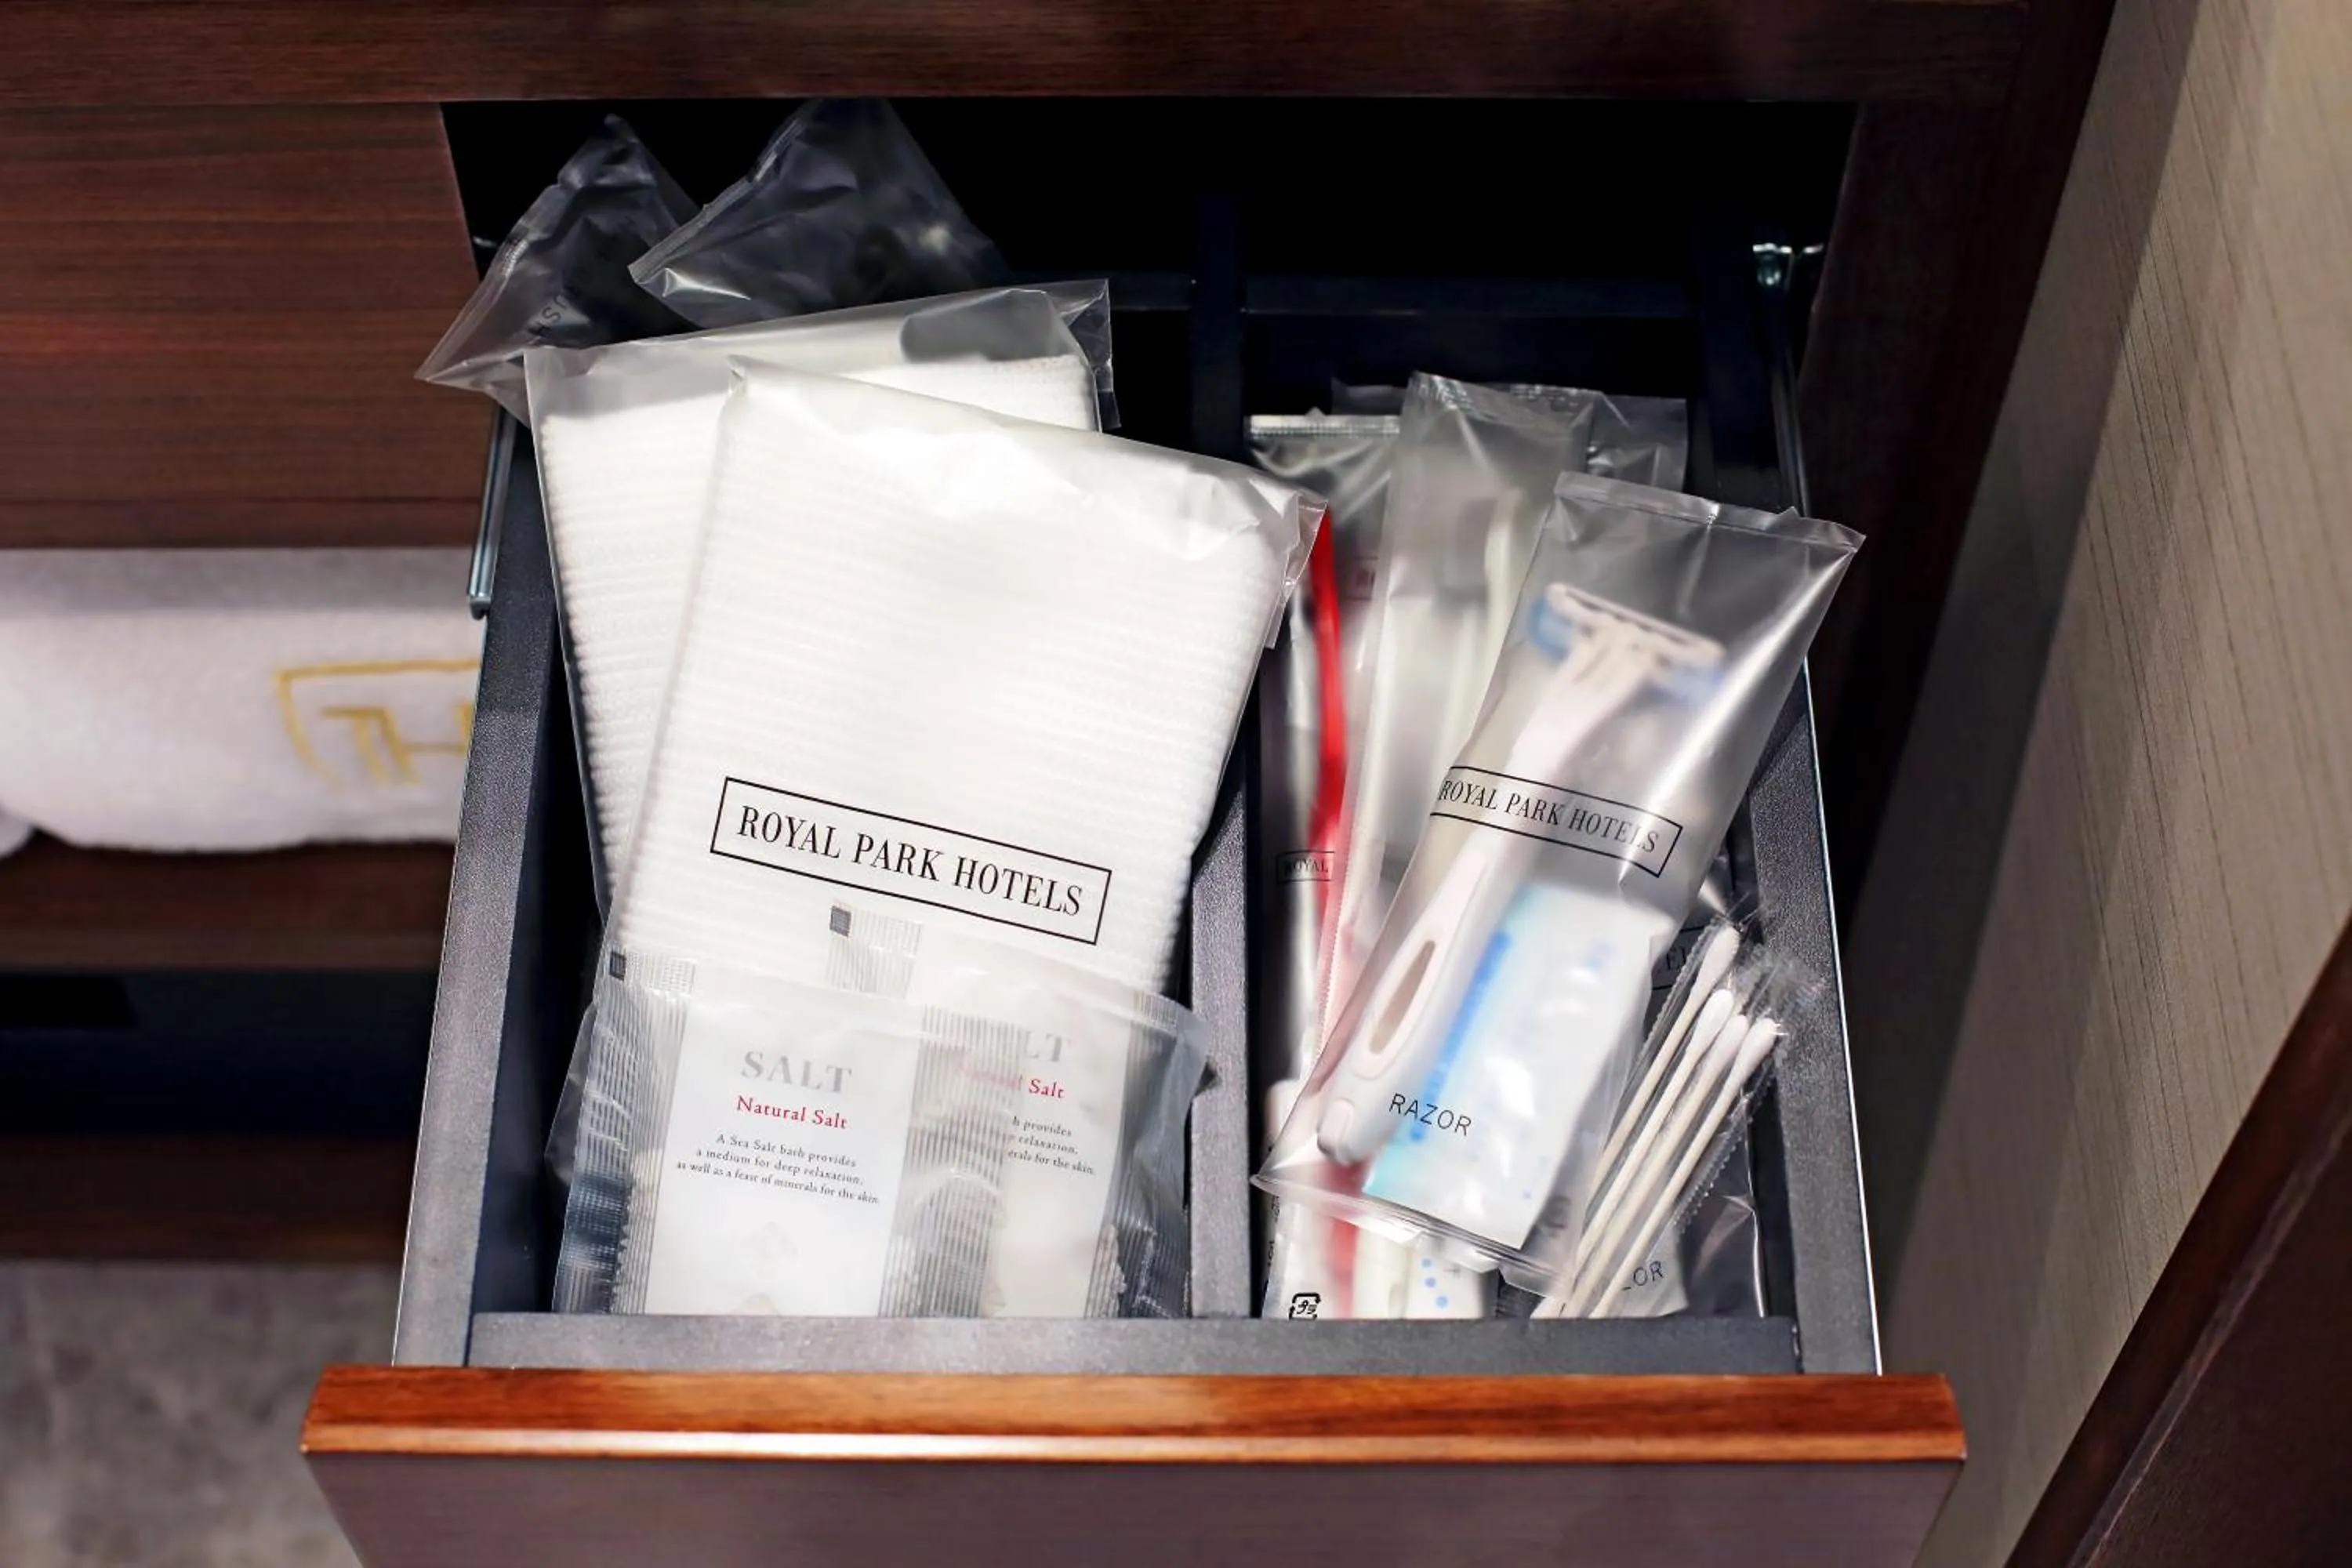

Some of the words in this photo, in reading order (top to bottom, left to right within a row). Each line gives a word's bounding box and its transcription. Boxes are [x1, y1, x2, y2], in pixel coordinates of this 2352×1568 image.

[1437, 779, 1497, 810] ROYAL
[1504, 793, 1565, 826] PARK
[1567, 808, 1660, 853] HOTELS
[736, 805, 840, 858] ROYAL
[851, 833, 942, 882] PARK
[953, 855, 1083, 916] HOTELS
[741, 1051, 852, 1094] SALT
[1029, 1078, 1065, 1099] Salt
[736, 1095, 807, 1122] Natural
[812, 1109, 848, 1130] Salt
[1023, 1117, 1073, 1137] provides
[1388, 1092, 1472, 1137] RAZOR
[706, 1149, 751, 1166] medium
[754, 1156, 771, 1169] for
[774, 1160, 800, 1177] deep
[715, 1134, 725, 1145] A
[729, 1134, 749, 1149] Sea
[753, 1139, 776, 1153] Salt
[780, 1144, 805, 1159] bath
[808, 1151, 857, 1168] provides
[1034, 1152, 1051, 1166] for
[1052, 1155, 1069, 1168] the
[690, 1162, 710, 1174] well
[734, 1169, 758, 1183] feast
[761, 1175, 773, 1185] of
[774, 1178, 818, 1194] minerals
[820, 1184, 835, 1196] for
[837, 1186, 854, 1200] the
